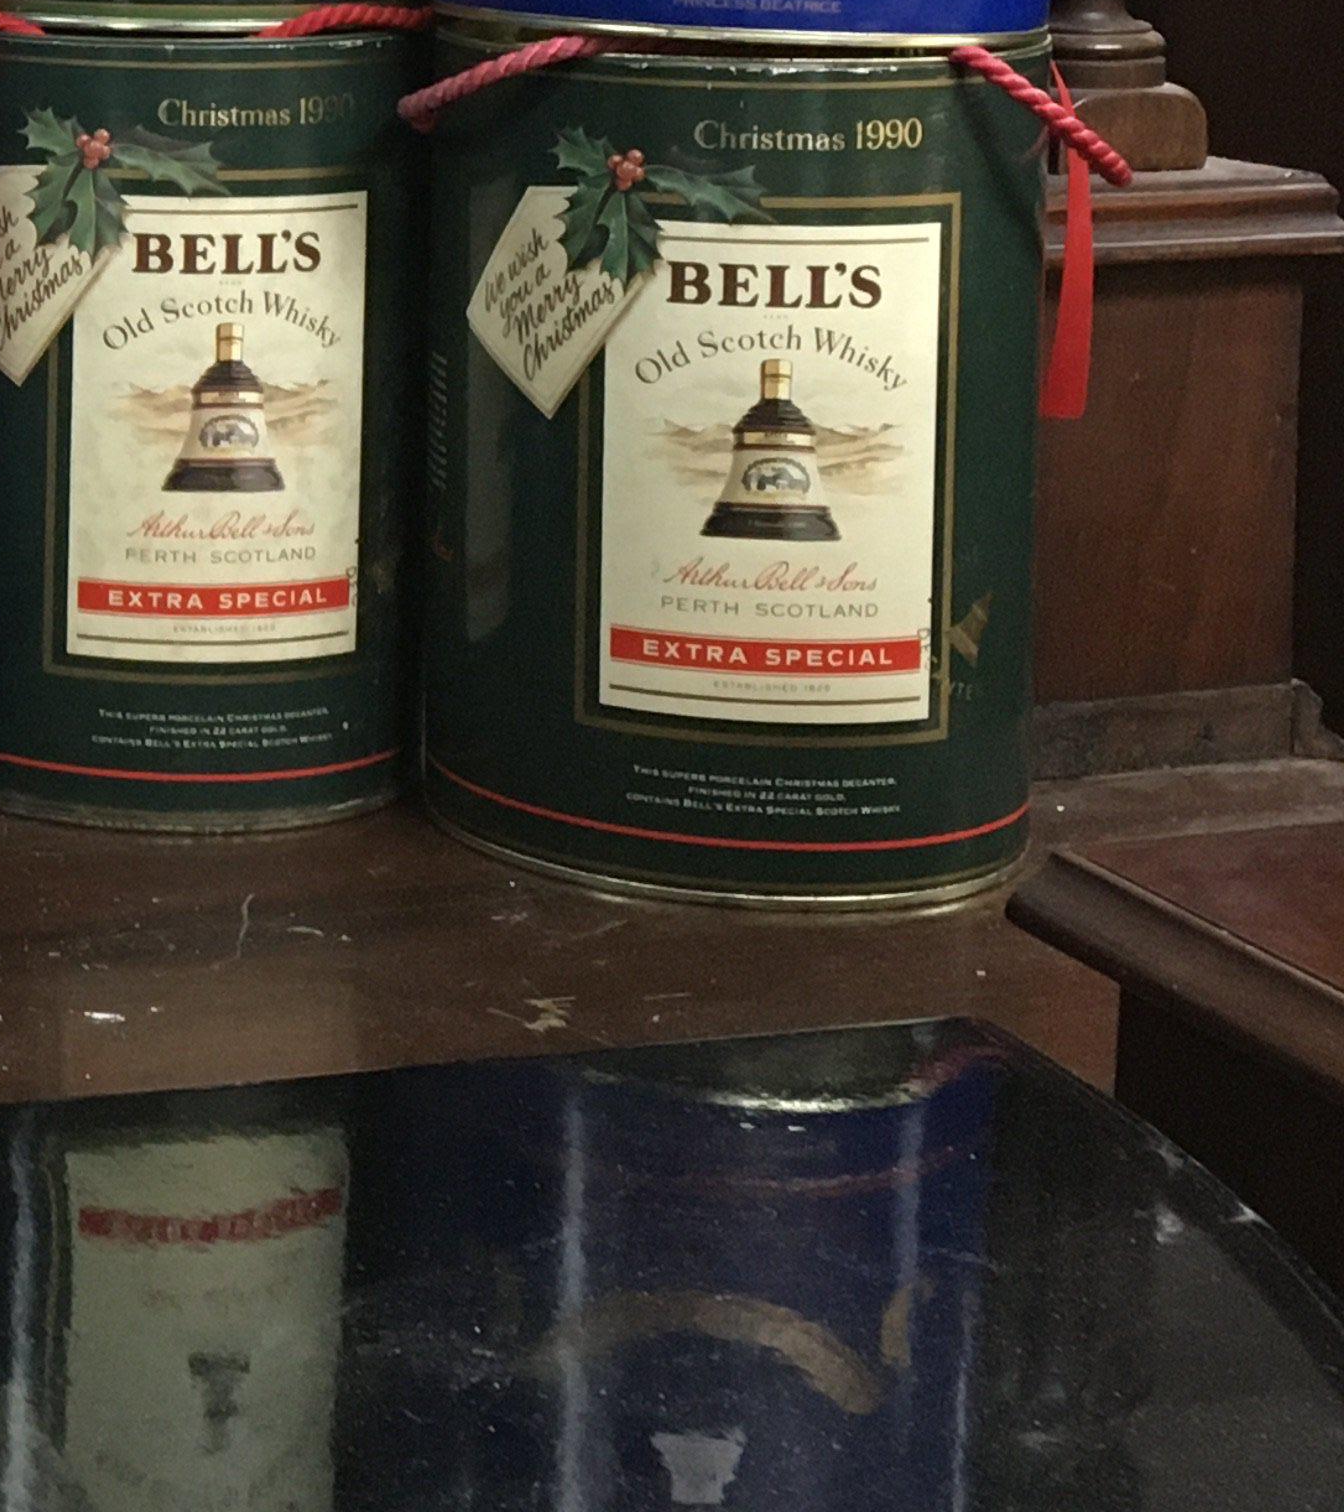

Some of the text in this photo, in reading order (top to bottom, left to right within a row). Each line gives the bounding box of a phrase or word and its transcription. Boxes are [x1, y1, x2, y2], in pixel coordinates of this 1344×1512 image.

[158, 98, 291, 127] Christmas
[694, 118, 924, 151] Christmas 1990
[5, 239, 21, 261] a
[131, 229, 320, 274] BELL'S
[499, 263, 552, 337] you a
[666, 261, 882, 308] BELL'S
[103, 289, 341, 350] Old Scotch Whisky
[514, 271, 582, 345] Merry
[523, 280, 614, 382] Christmas
[635, 325, 907, 392] Old Scotch Whisky
[126, 547, 316, 563] PERTH SCOTLAND
[108, 588, 327, 609] EXTRA SPECIAL
[661, 596, 878, 619] PERTH SCOTLAND
[643, 638, 892, 666] EXTRA SPECIAL
